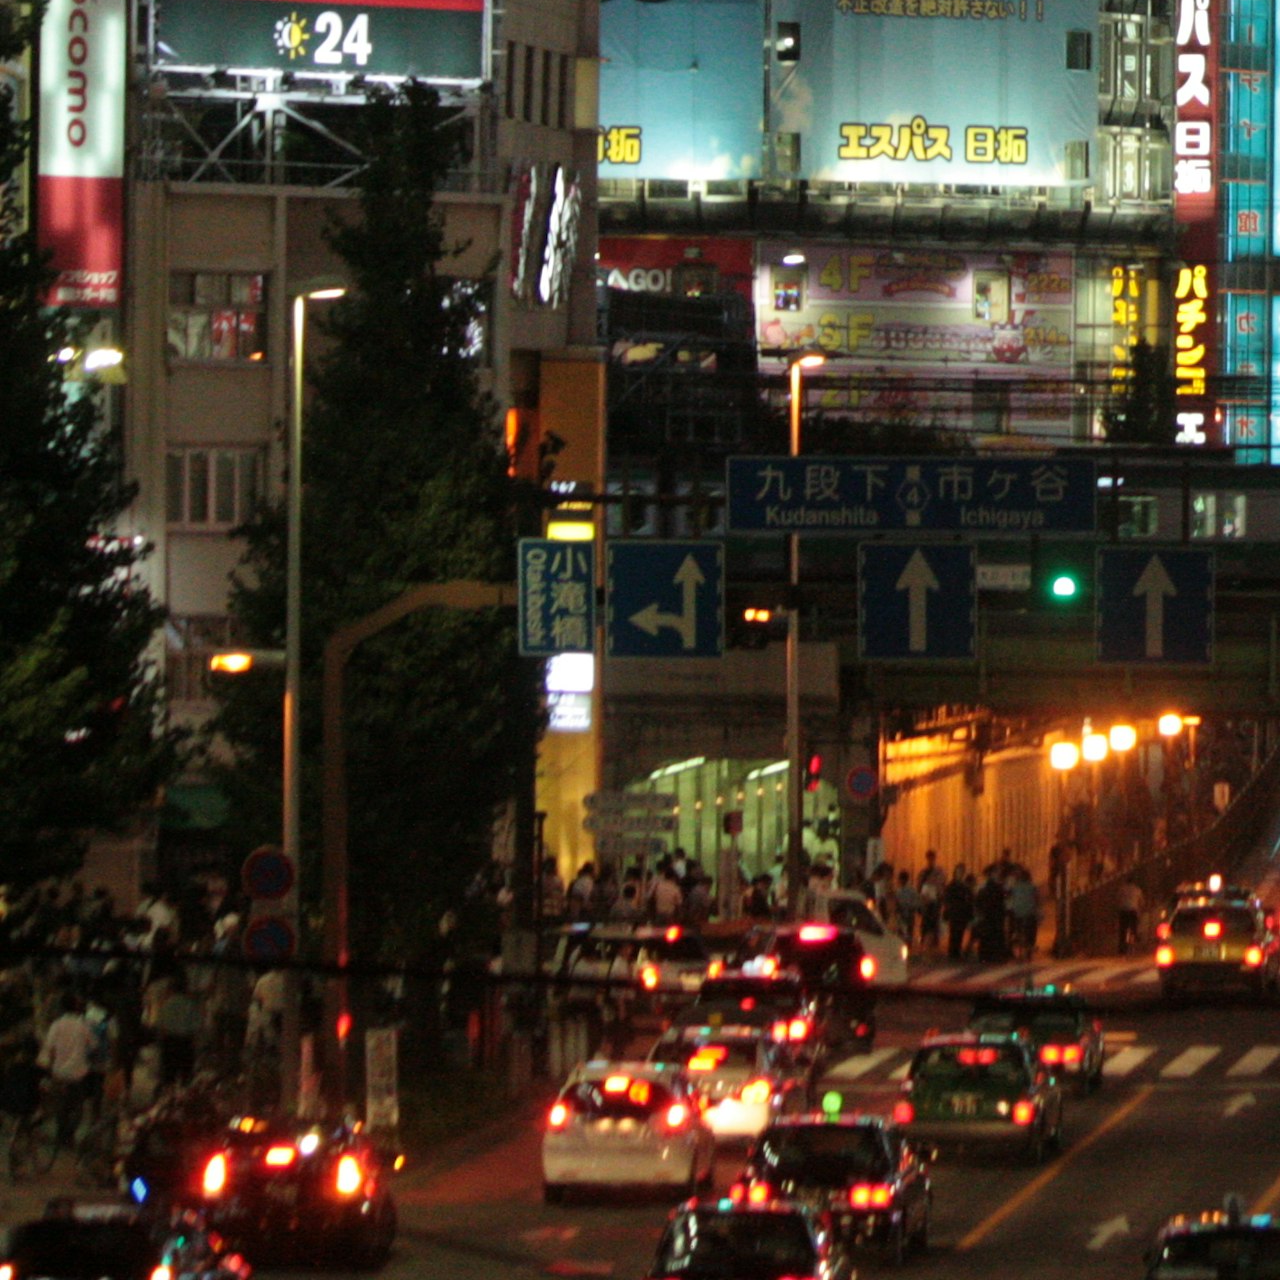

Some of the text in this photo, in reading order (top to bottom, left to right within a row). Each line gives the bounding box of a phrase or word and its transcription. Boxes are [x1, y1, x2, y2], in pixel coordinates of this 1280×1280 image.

[313, 10, 372, 66] 24
[598, 126, 642, 165] 拓
[838, 115, 1029, 164] エスパス 日拓
[1173, 120, 1213, 195] 日拓
[818, 253, 875, 293] 4F
[817, 313, 875, 353] 3F
[1175, 265, 1209, 396] パチンコ
[755, 463, 891, 503] 九段下
[764, 505, 1045, 528] Kudanshita Ichigaya
